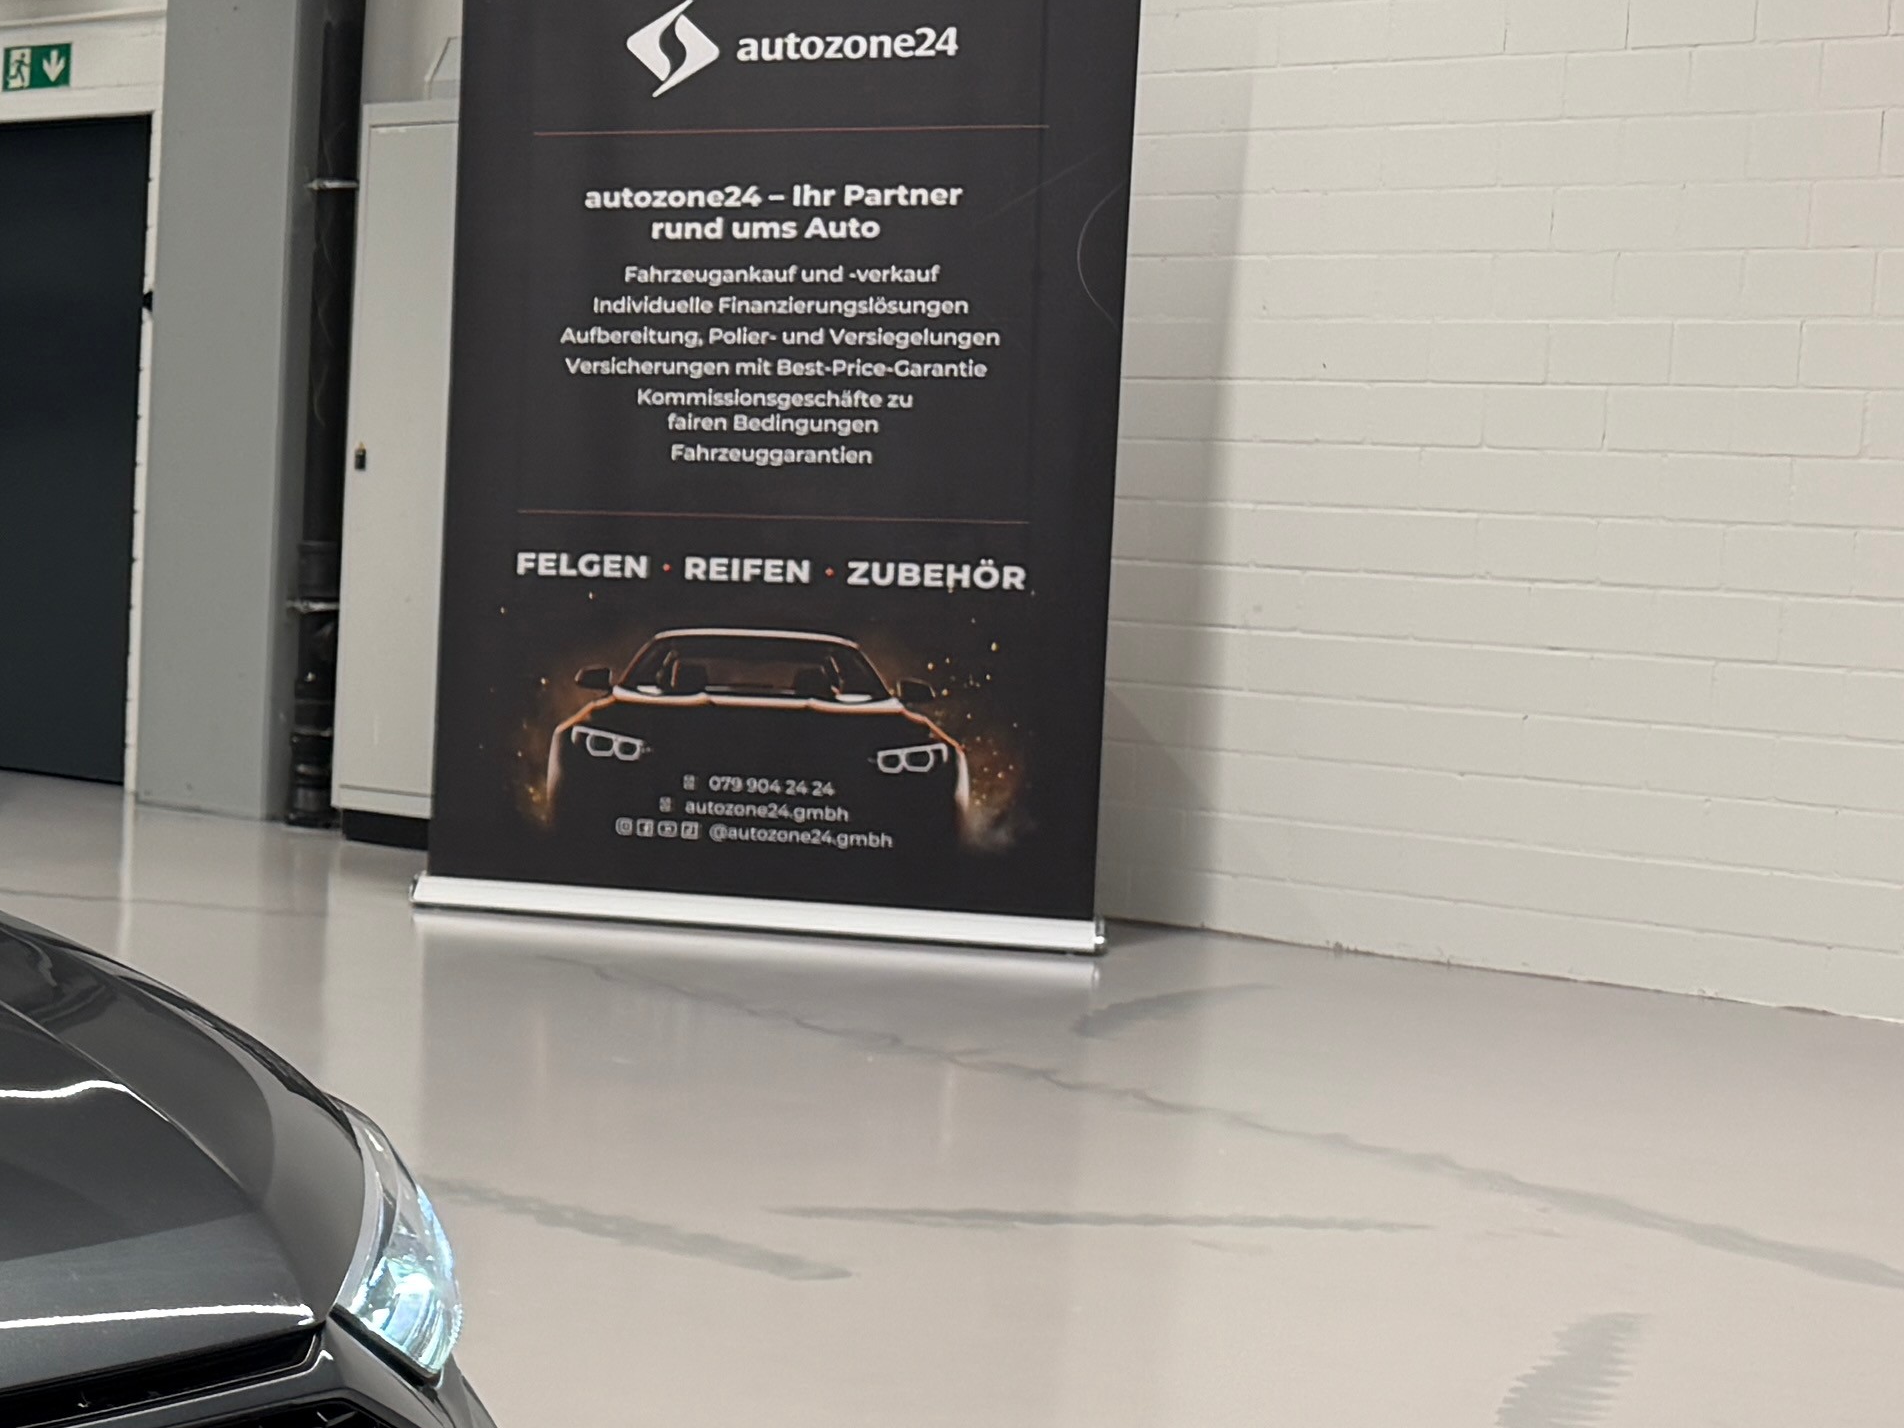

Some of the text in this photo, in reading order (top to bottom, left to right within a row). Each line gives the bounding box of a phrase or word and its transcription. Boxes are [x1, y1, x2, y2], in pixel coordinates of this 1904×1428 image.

[736, 26, 959, 62] autozone24
[584, 185, 763, 209] autozone24
[792, 183, 837, 207] Ihr
[843, 184, 964, 207] Partner
[651, 216, 881, 240] rund ums Auto
[624, 264, 941, 287] Fahrzeugankauf und -verkauf
[593, 295, 969, 318] Individuelle Finanzierungslösungen
[560, 325, 1001, 350] Aufbereitung, Polier- und Versiegelungen
[564, 356, 988, 379] Versicherungen mit Best-Price-Garantie
[637, 387, 914, 411] Kommissionsgeschäfte zu
[667, 412, 879, 437] fairen Bedingungen
[670, 443, 873, 467] Fahrzeuggarantien
[516, 552, 1026, 590] FELGEN REIFEN ZUBEHÖR
[708, 775, 836, 797] 079 904 24 24
[685, 801, 849, 823] autozone24.gmbh
